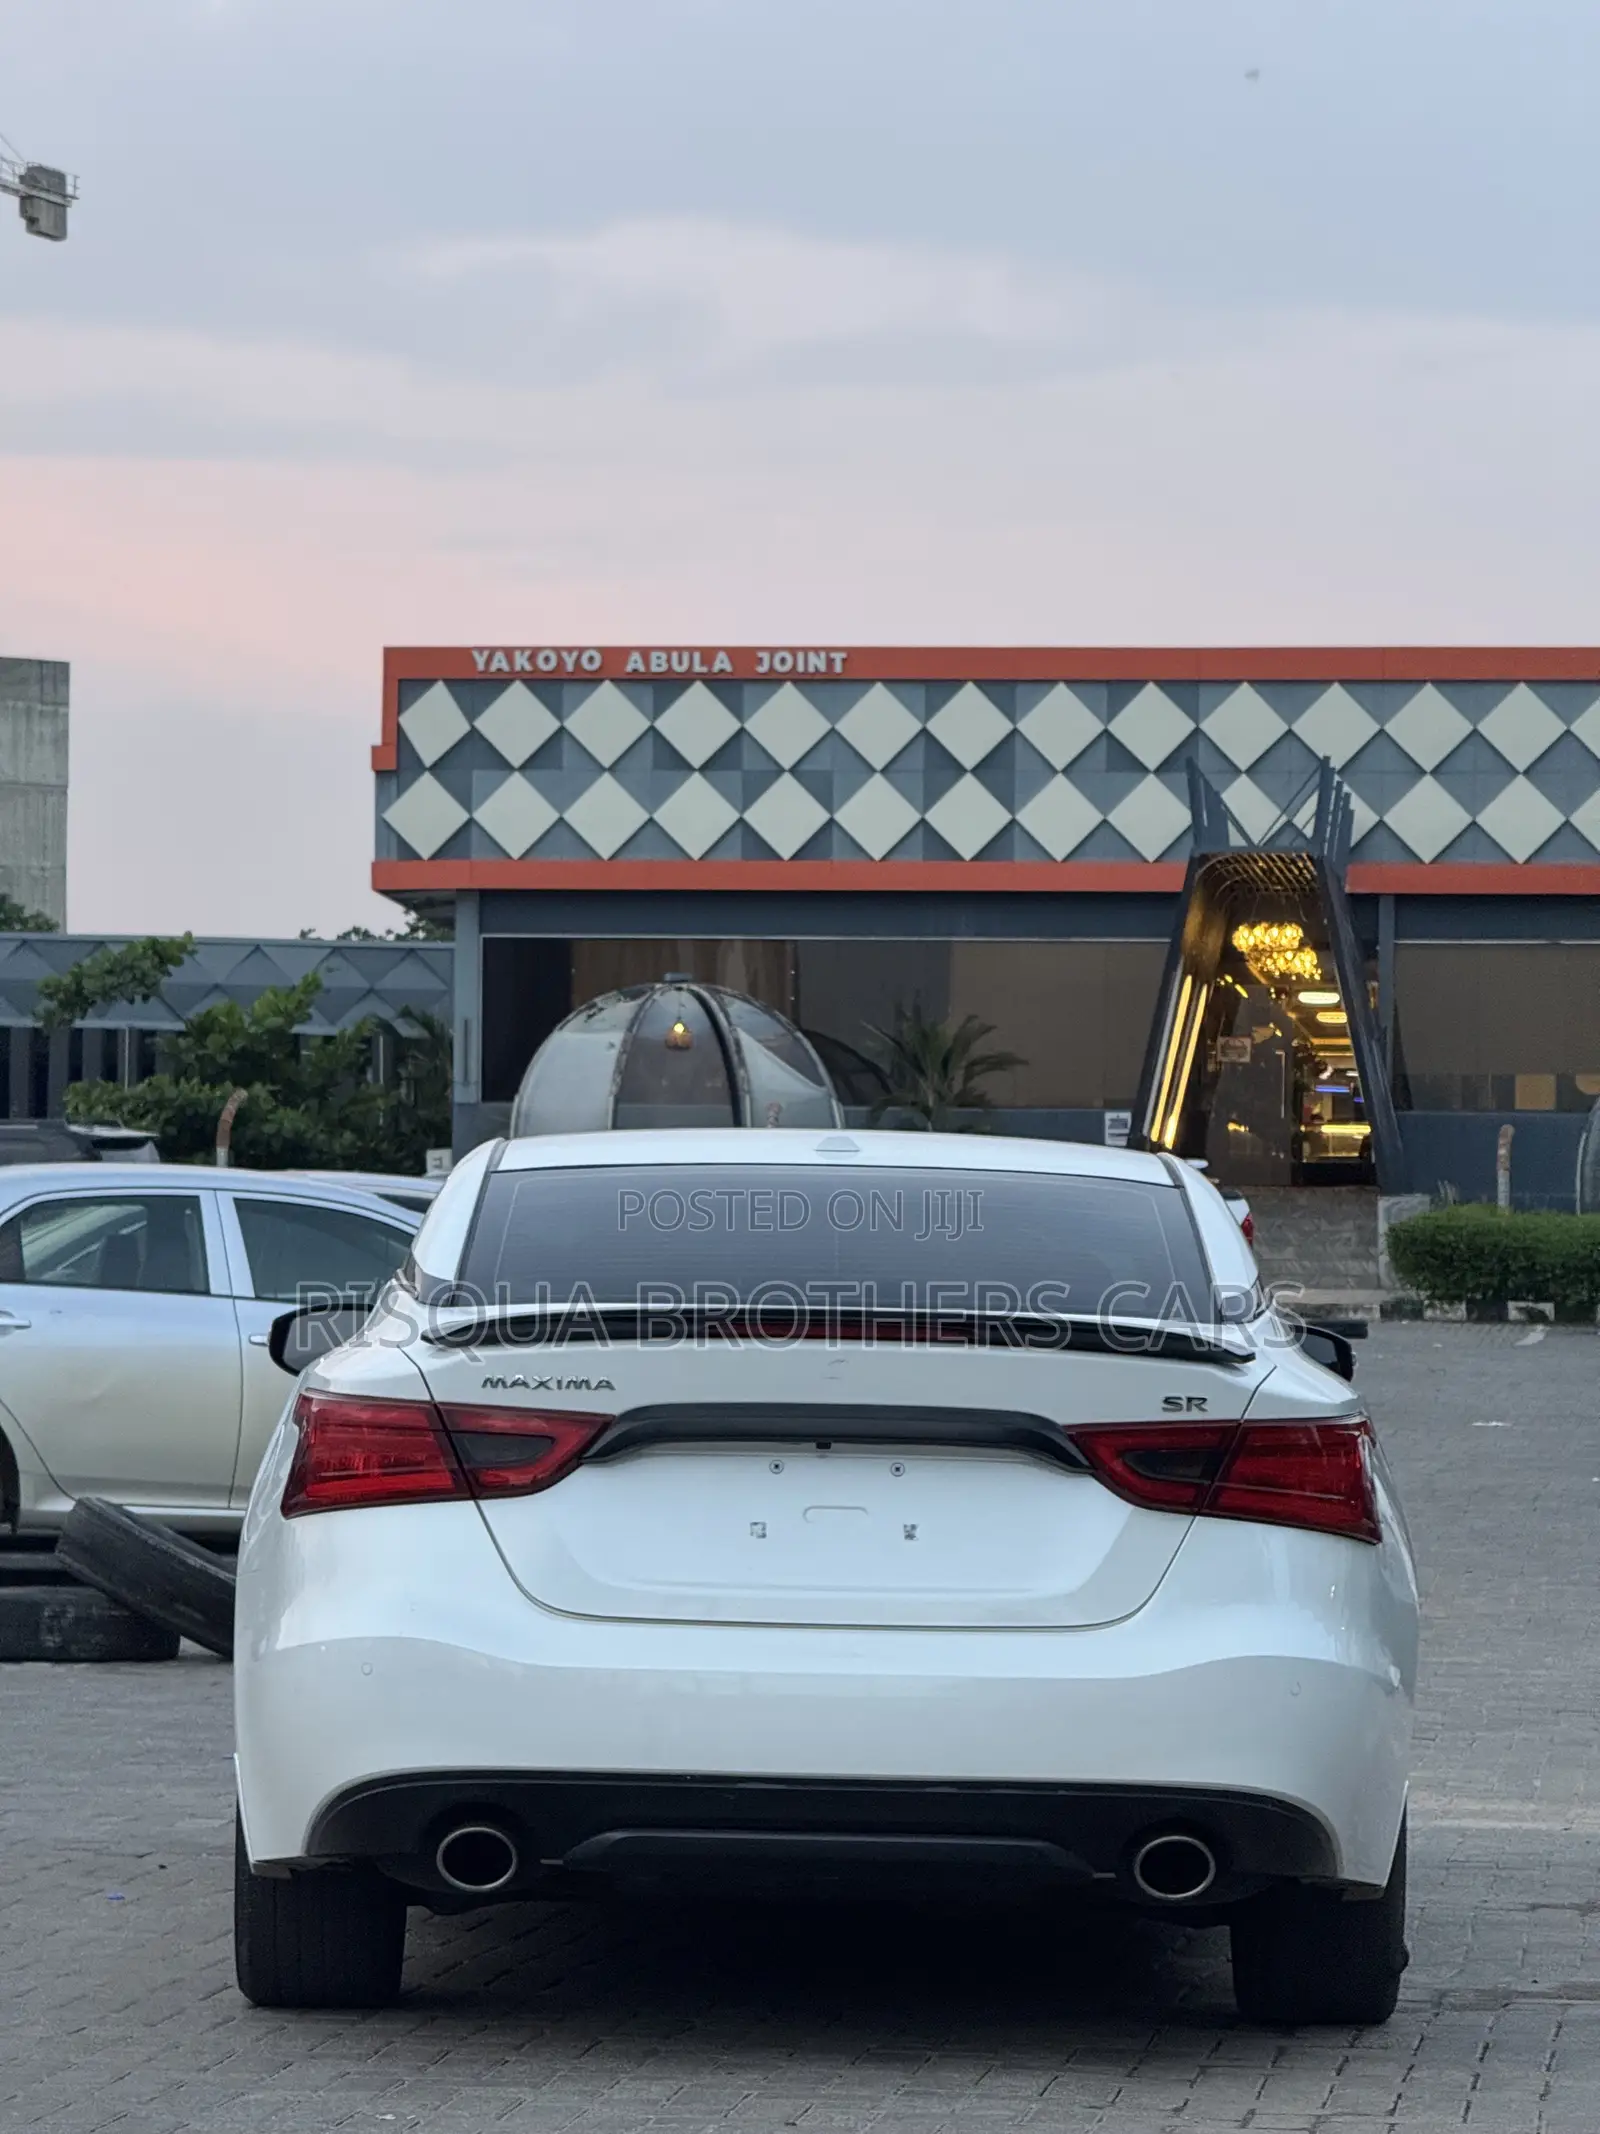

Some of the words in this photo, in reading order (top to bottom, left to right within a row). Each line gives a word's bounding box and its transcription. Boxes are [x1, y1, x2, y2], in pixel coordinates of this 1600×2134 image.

[471, 648, 603, 673] YAKOYO
[625, 650, 734, 673] ABULA
[755, 651, 848, 674] JOINT
[481, 1374, 617, 1392] MAXIMA
[1161, 1395, 1209, 1413] SR
